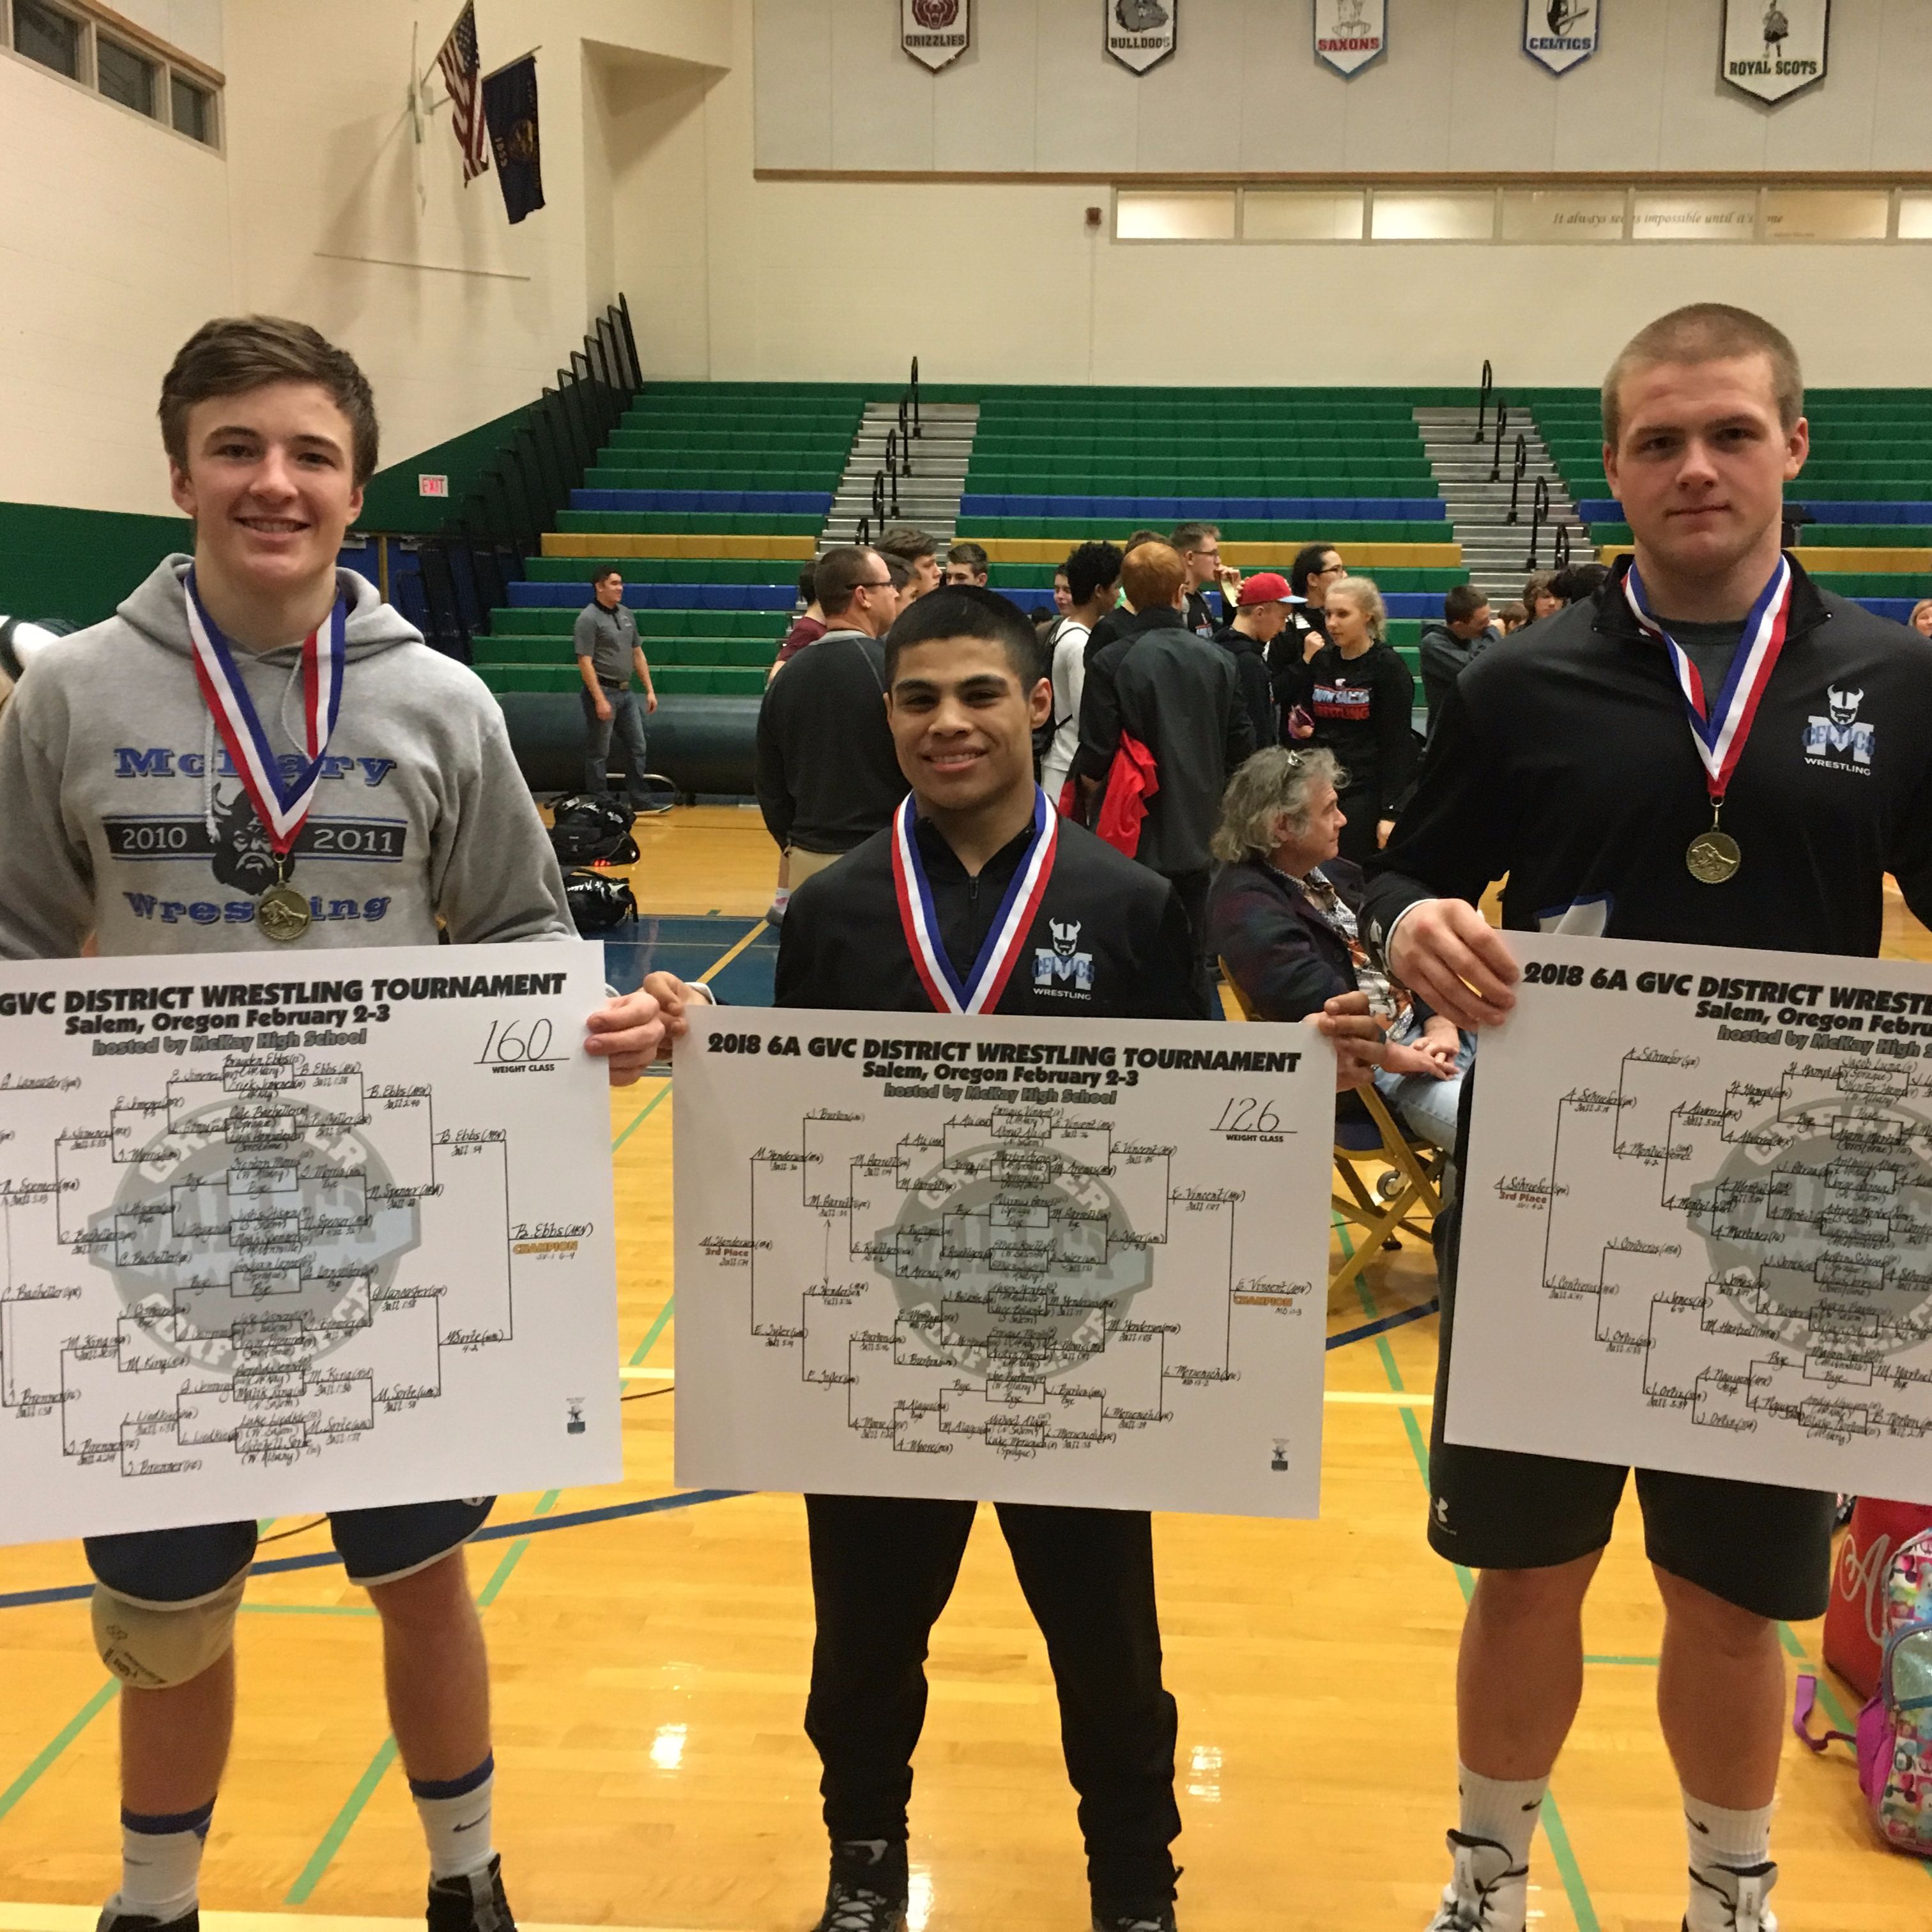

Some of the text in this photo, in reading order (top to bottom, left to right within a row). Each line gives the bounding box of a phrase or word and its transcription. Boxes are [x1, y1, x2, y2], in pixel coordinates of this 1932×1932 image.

[905, 33, 965, 47] GRIZZLIES
[1318, 37, 1380, 52] SAXONS
[1529, 37, 1591, 50] CELTICS
[1729, 60, 1817, 75] ROYAL SCOTS
[1553, 213, 1564, 224] It
[1567, 211, 1606, 228] always
[1644, 211, 1701, 227] impossible
[1705, 211, 1735, 223] until
[422, 479, 444, 493] EXIT
[1804, 757, 1871, 776] WRESTLING
[123, 827, 187, 850] 2010
[314, 829, 393, 853] 2011
[65, 986, 194, 1013] DISTRICT
[201, 980, 363, 1008] WRESTLING
[371, 972, 567, 1001] TOURNAMENT
[1522, 962, 1584, 986] 2018
[1590, 967, 1628, 991] 6A
[1636, 971, 1693, 996] GVC
[1697, 976, 1824, 1006] DISTRICT
[1032, 988, 1091, 1000] WRESTLING
[65, 1004, 390, 1035] Salem, Oregon February 2-3
[1695, 1000, 1771, 1025] Salem,
[1777, 1007, 1864, 1032] Oregon
[92, 1028, 367, 1056] hosted by McKay High School
[480, 1018, 553, 1063] 160
[1717, 1024, 1782, 1045] hosted
[1785, 1030, 1810, 1050] by
[1810, 1033, 1874, 1056] McKay
[1876, 1038, 1921, 1059] High
[707, 1032, 1302, 1073] 2018 6A GVC DISTRICT WRESTLING TOURNAMENT
[492, 1063, 555, 1073] WEIGHT CLASS
[862, 1061, 1139, 1089] Salem, Oregon February 2-3
[383, 1084, 406, 1098] Ebbs
[884, 1082, 1117, 1105] hosted by McKay High School
[1216, 1098, 1280, 1133] 126
[456, 1128, 480, 1142] Ebbs
[1225, 1134, 1284, 1143] WEIGHT CLASS
[1499, 1192, 1547, 1204] 3rd Place
[535, 1222, 564, 1238] Ebbs
[705, 1248, 749, 1257] 3rd Place
[1250, 1275, 1288, 1293] Vincent
